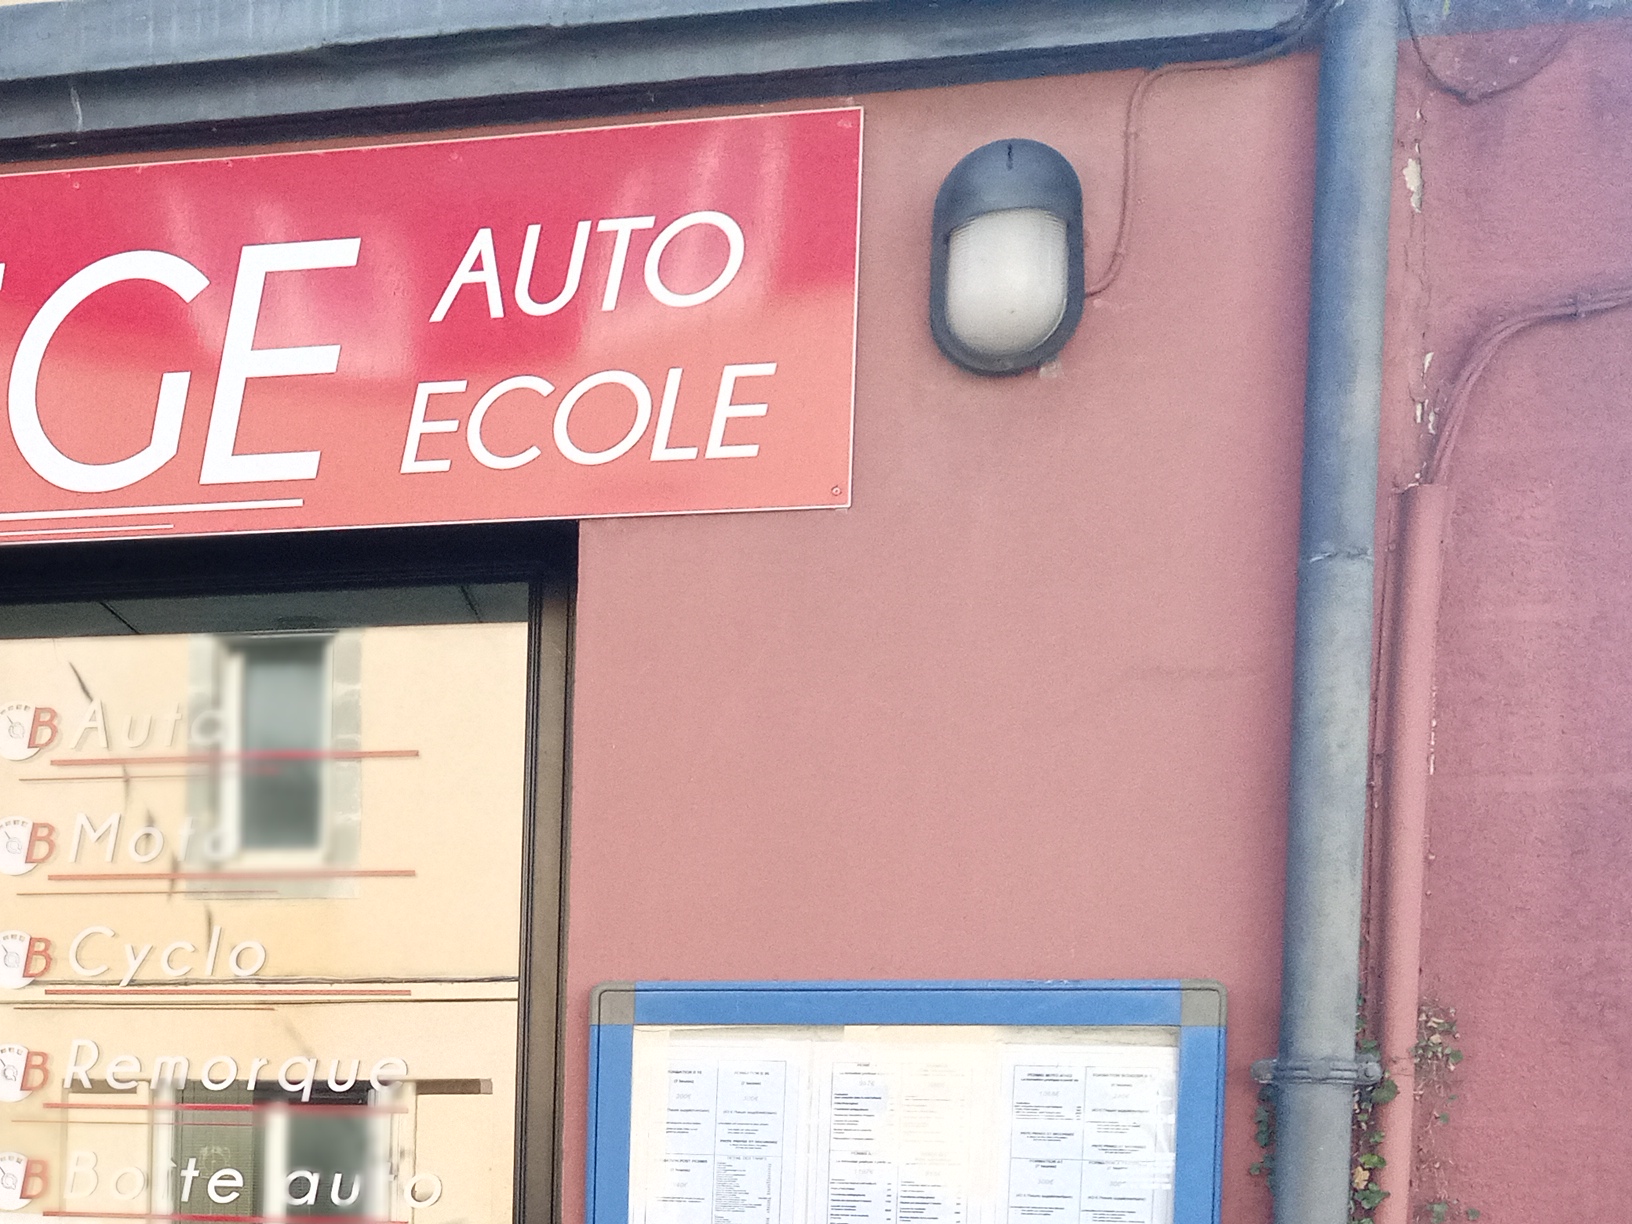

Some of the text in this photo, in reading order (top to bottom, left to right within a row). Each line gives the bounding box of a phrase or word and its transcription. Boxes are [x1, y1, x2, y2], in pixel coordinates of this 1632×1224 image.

[430, 211, 744, 322] AUTO
[400, 363, 776, 474] ECOLE
[69, 812, 232, 863] Moto
[70, 926, 266, 987] Cyclo
[63, 1039, 408, 1102] Remorque
[63, 1151, 244, 1204] Bote
[284, 1161, 443, 1208] auo
